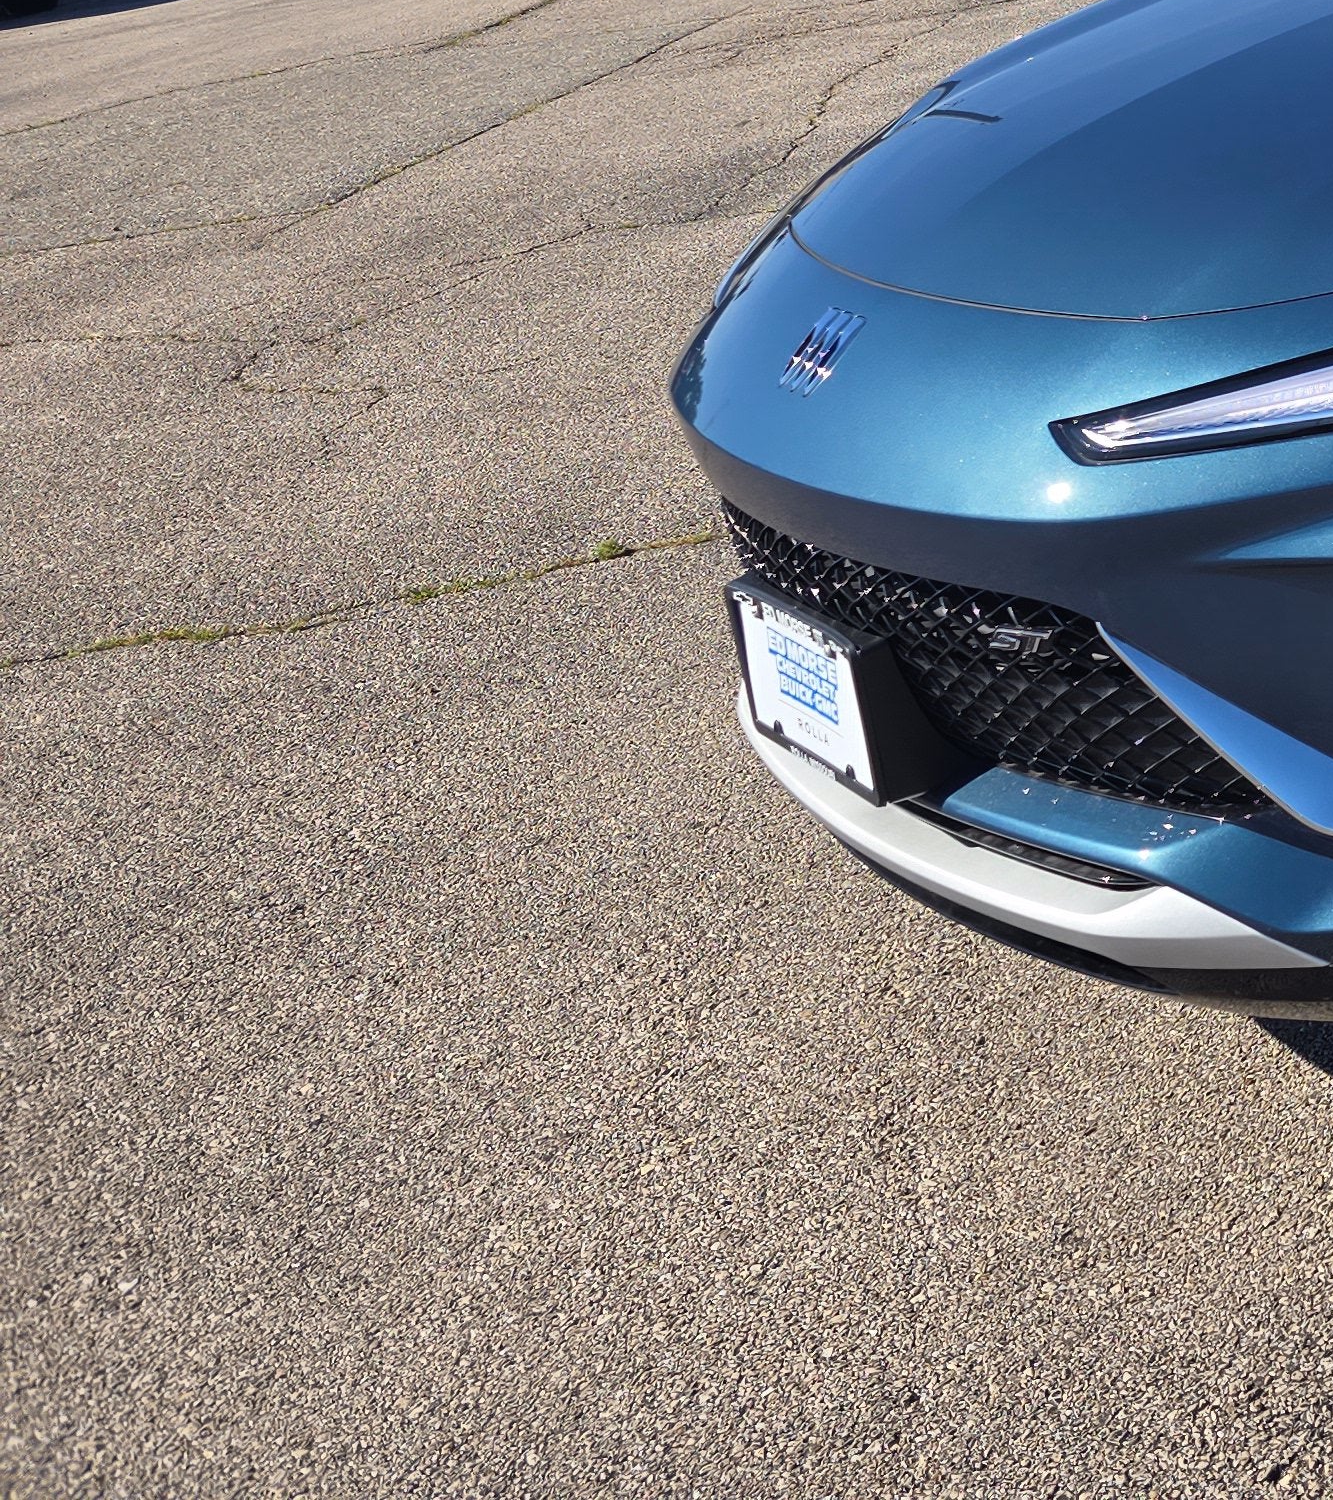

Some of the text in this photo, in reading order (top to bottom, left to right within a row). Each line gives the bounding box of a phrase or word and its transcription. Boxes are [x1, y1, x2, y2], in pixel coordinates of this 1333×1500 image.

[768, 628, 786, 655] ED
[785, 638, 837, 684] MORSE
[989, 627, 1053, 653] ST
[777, 654, 835, 701] CHEVROLET
[797, 717, 830, 746] ROLLA
